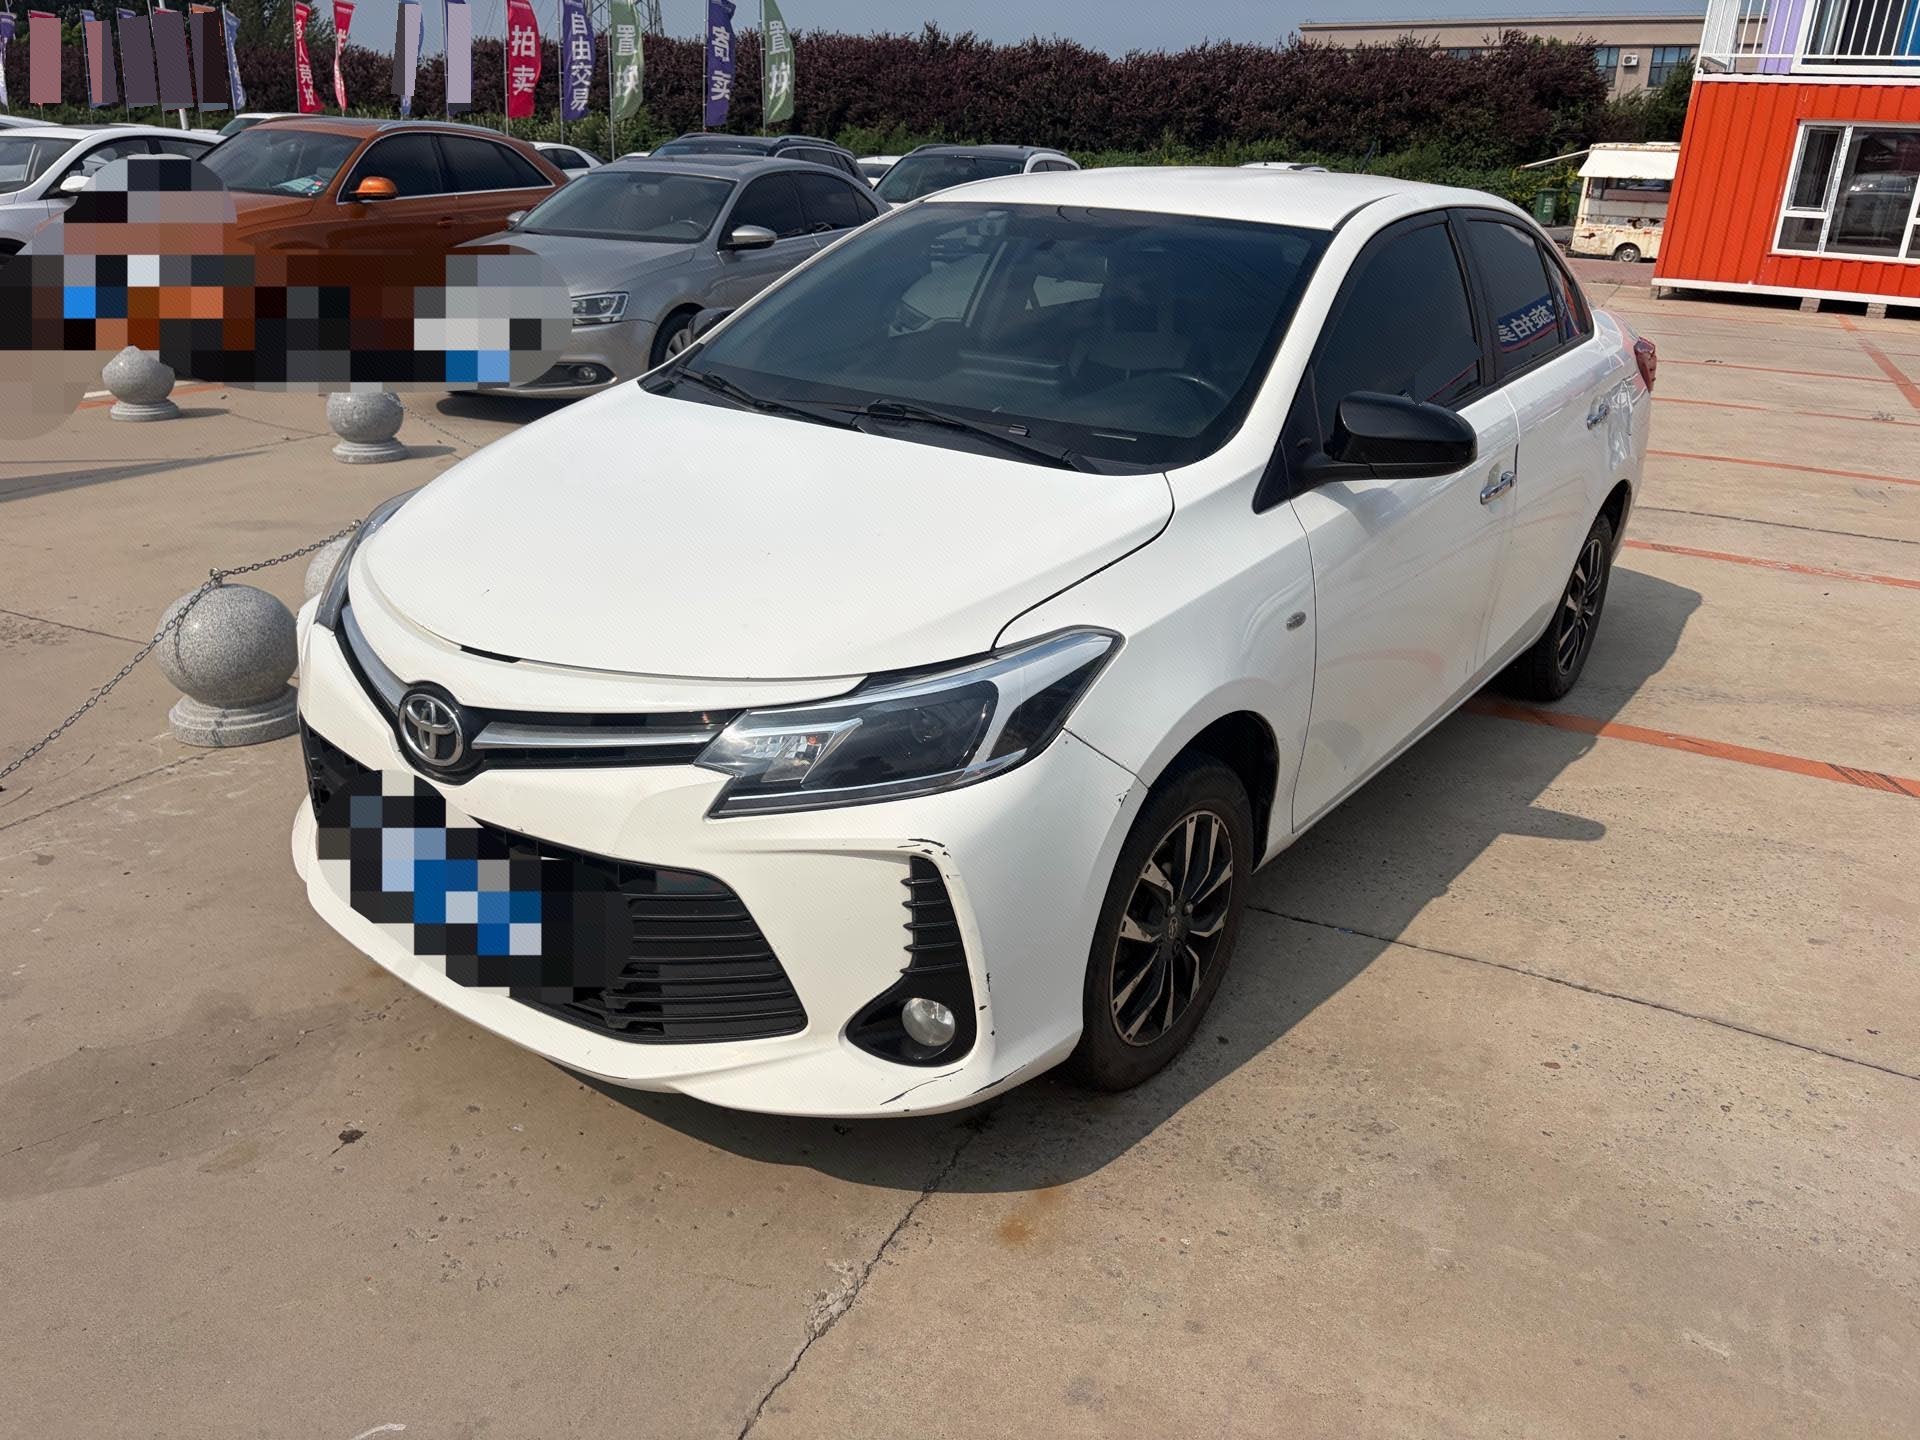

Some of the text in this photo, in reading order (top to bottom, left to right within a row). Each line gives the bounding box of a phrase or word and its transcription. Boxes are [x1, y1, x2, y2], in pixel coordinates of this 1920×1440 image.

[510, 24, 537, 96] 拍卖
[570, 11, 593, 111] 自由交易
[615, 24, 640, 97] 置换
[768, 19, 792, 100] 置换
